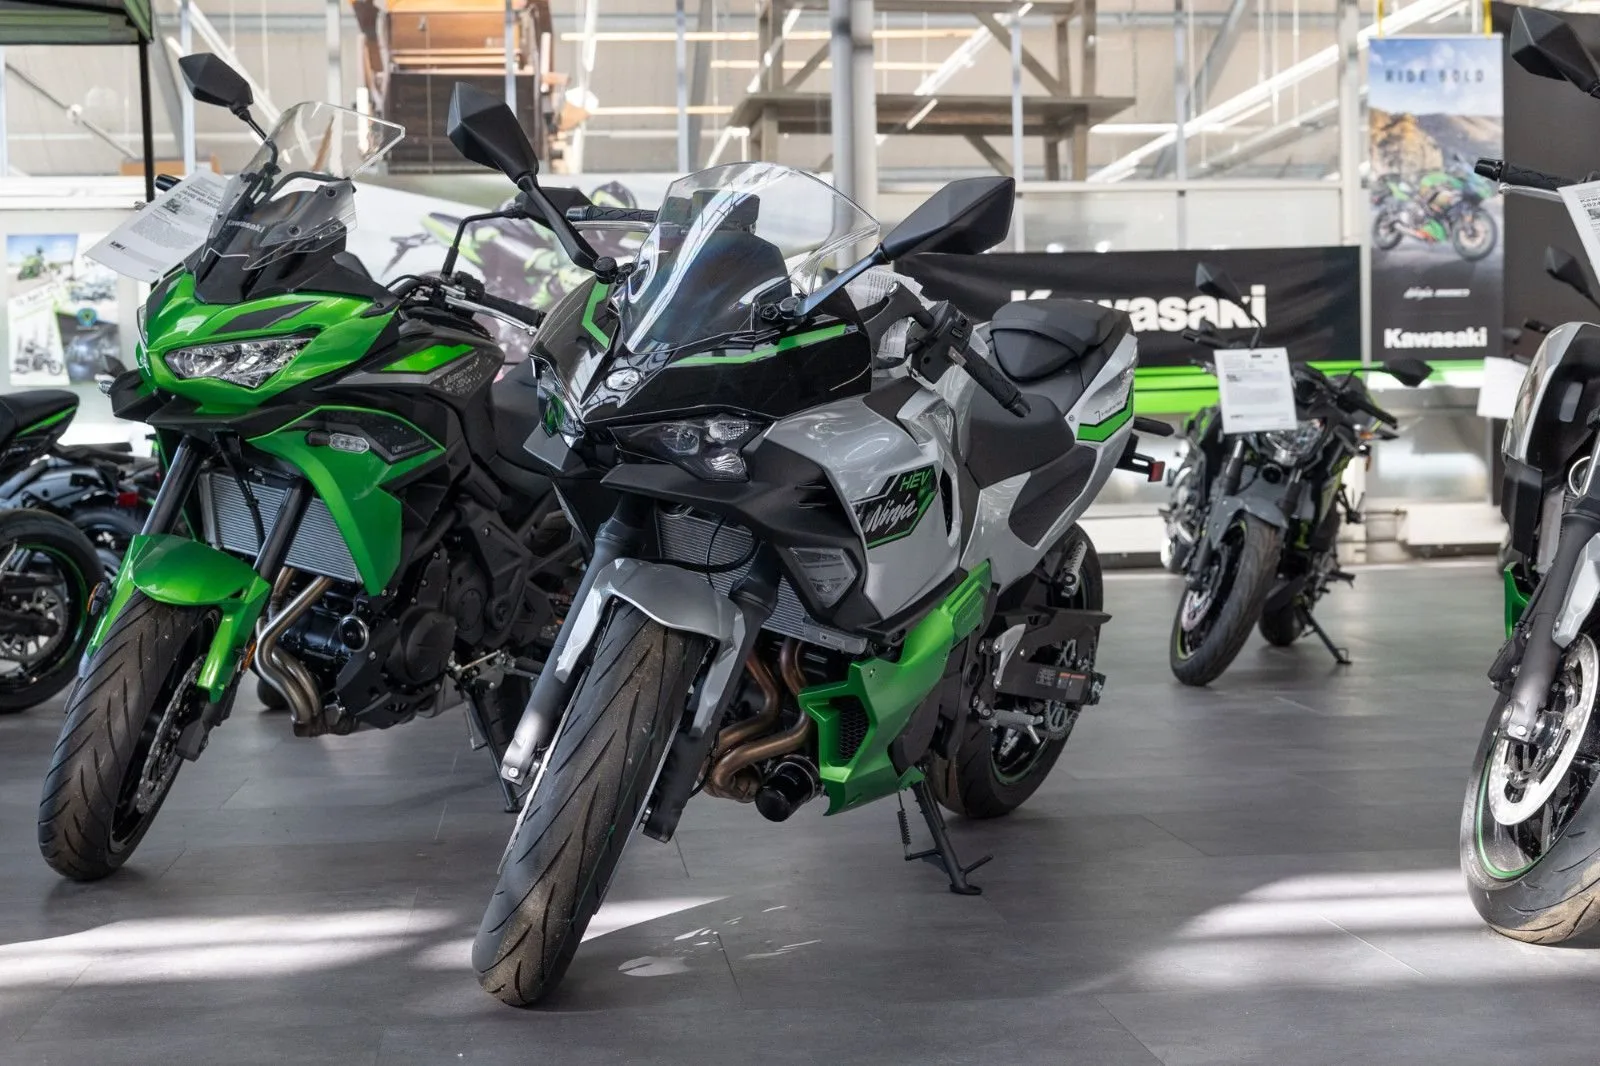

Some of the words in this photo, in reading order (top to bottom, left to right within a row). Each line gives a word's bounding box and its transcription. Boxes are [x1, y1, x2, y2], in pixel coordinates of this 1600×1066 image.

[1385, 69, 1426, 83] RIDE
[1439, 69, 1484, 83] BOLD
[1384, 326, 1488, 349] Kawasaki
[899, 469, 932, 492] HEV
[864, 493, 918, 534] Ninja
